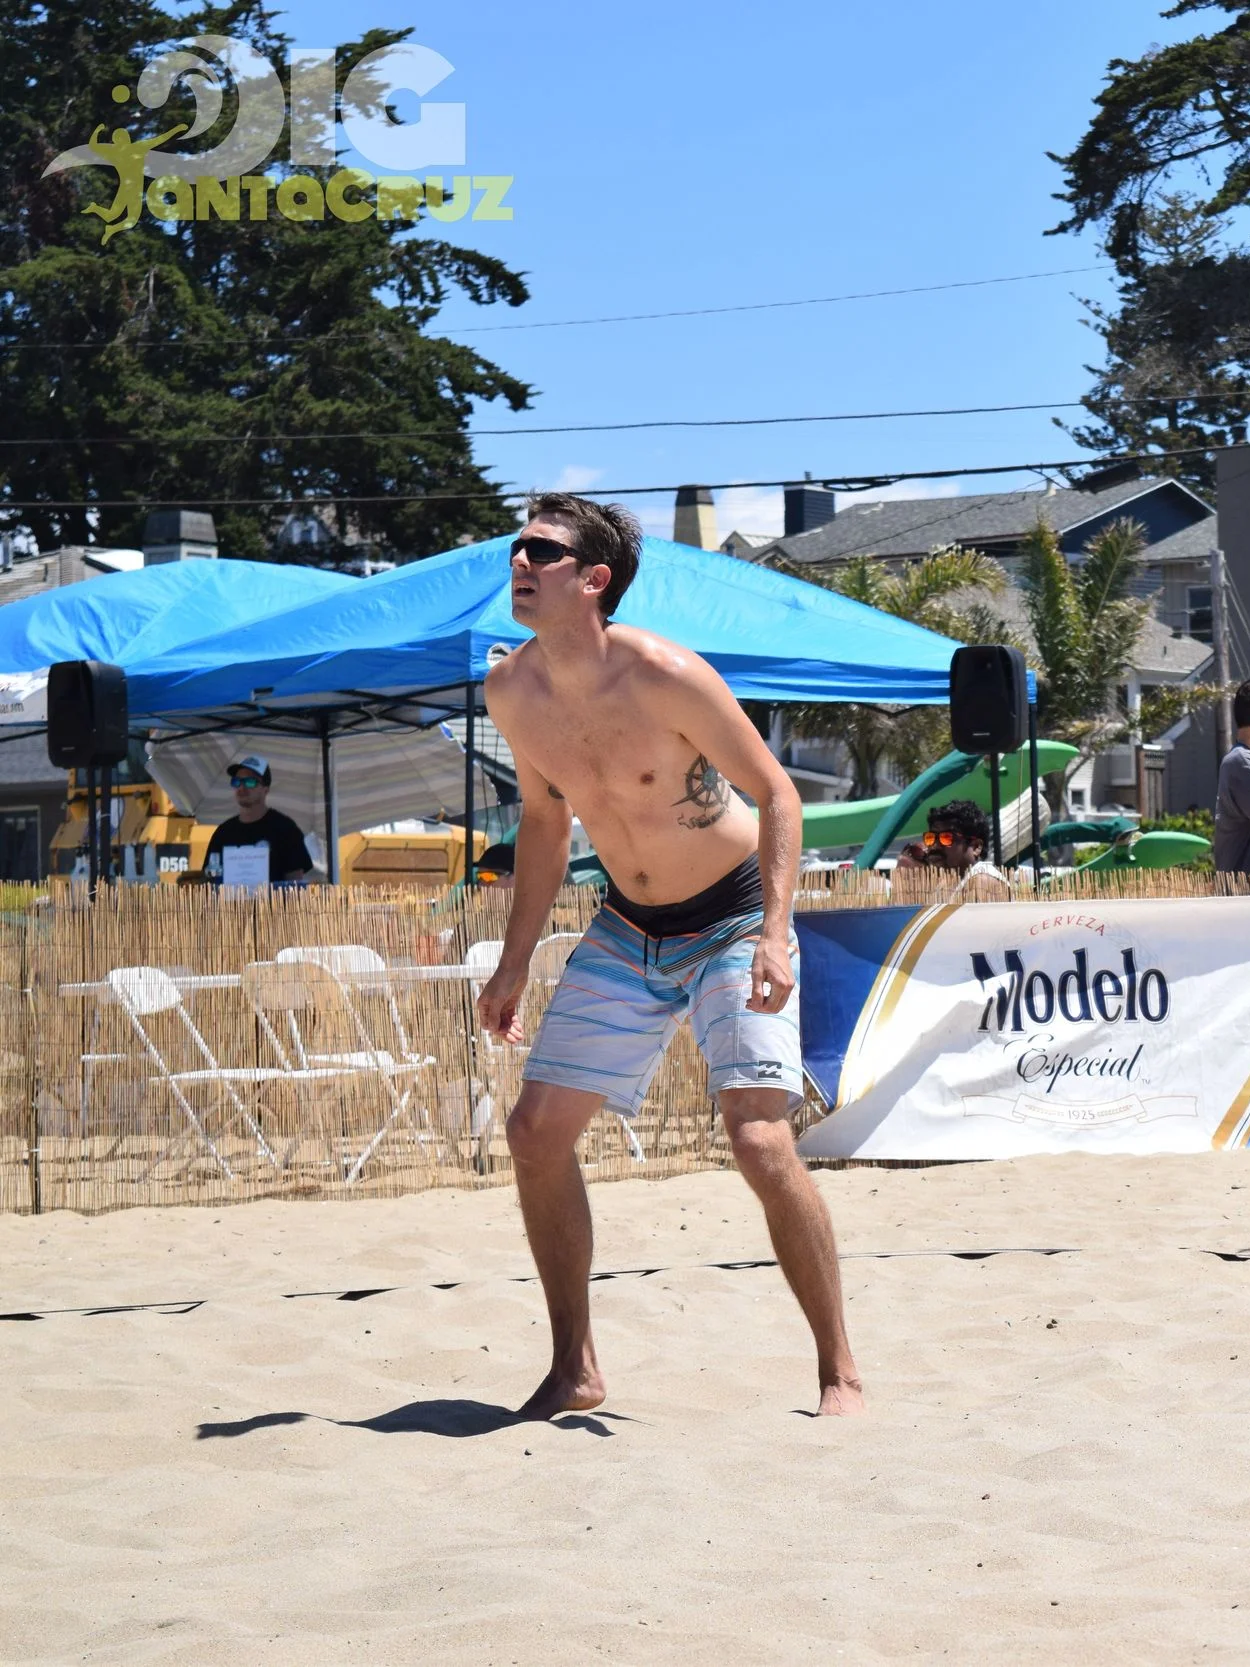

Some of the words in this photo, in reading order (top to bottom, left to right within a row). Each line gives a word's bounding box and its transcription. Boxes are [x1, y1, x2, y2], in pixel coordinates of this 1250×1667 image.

[160, 856, 189, 873] D5G
[1029, 914, 1106, 937] CERVEZA
[969, 947, 1171, 1034] Modelo
[1003, 1033, 1142, 1093] Especial
[1068, 1109, 1096, 1121] 1925
